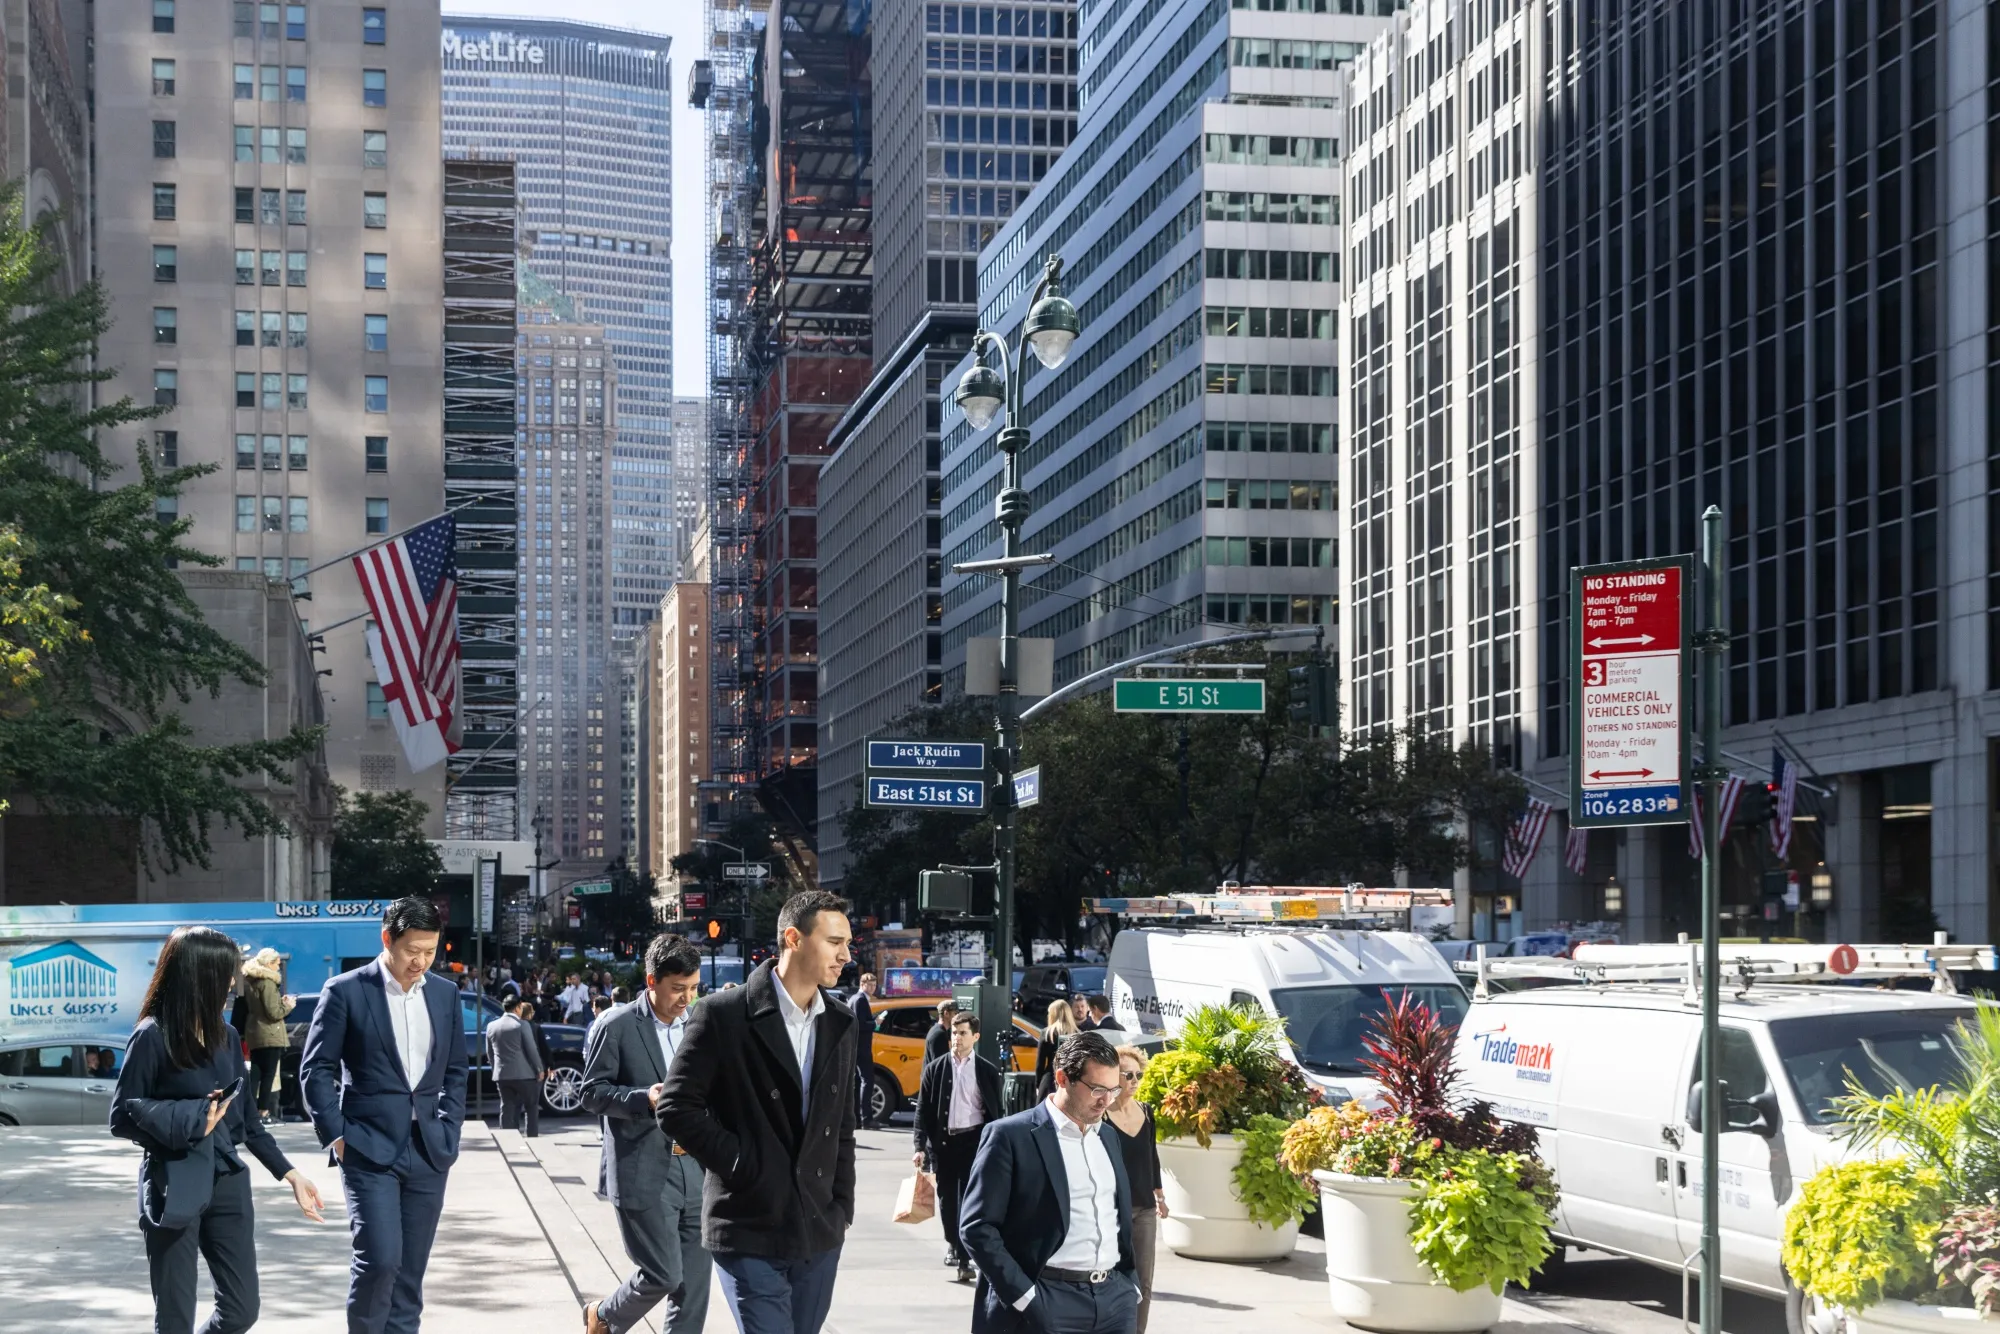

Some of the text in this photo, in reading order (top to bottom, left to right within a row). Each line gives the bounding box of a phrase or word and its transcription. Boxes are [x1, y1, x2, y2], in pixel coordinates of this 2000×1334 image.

[441, 35, 544, 63] MetLife
[1586, 573, 1666, 590] NO STANDING
[1586, 595, 1621, 606] Monday
[1629, 592, 1658, 603] Friday
[1587, 607, 1606, 617] 7am
[1614, 605, 1638, 615] 10am
[1587, 618, 1607, 629] 4pm
[1614, 616, 1634, 627] 7pm
[1586, 662, 1603, 686] 3
[1609, 668, 1642, 677] metered
[1608, 676, 1638, 685] parking
[1159, 686, 1220, 705] E 51 St
[1587, 690, 1660, 704] COMMERCIAL
[1587, 703, 1673, 718] VEHICLES ONLY
[1587, 720, 1677, 733] OTHERS NO STANDING
[1587, 739, 1620, 749] Monday
[1629, 737, 1657, 747] Friday
[892, 745, 961, 758] Jack Rudin
[1587, 750, 1610, 759] 10am
[1619, 749, 1638, 759] 4pm
[916, 757, 937, 767] Way
[877, 784, 975, 803] East 51st St
[1025, 781, 1034, 797] Ave
[1584, 791, 1609, 799] Zone#
[1584, 798, 1656, 816] 106283
[456, 848, 494, 857] ASTORIA
[728, 867, 740, 875] ONE
[275, 900, 382, 917] UNCLE GUSSY'S
[10, 1002, 118, 1016] UNCLE GUSSY'S
[1121, 993, 1184, 1018] Forest Electric
[12, 1015, 109, 1026] Traditional Greek Cuisine
[1479, 1033, 1554, 1070] Trademark
[1516, 1069, 1552, 1083] mechanical
